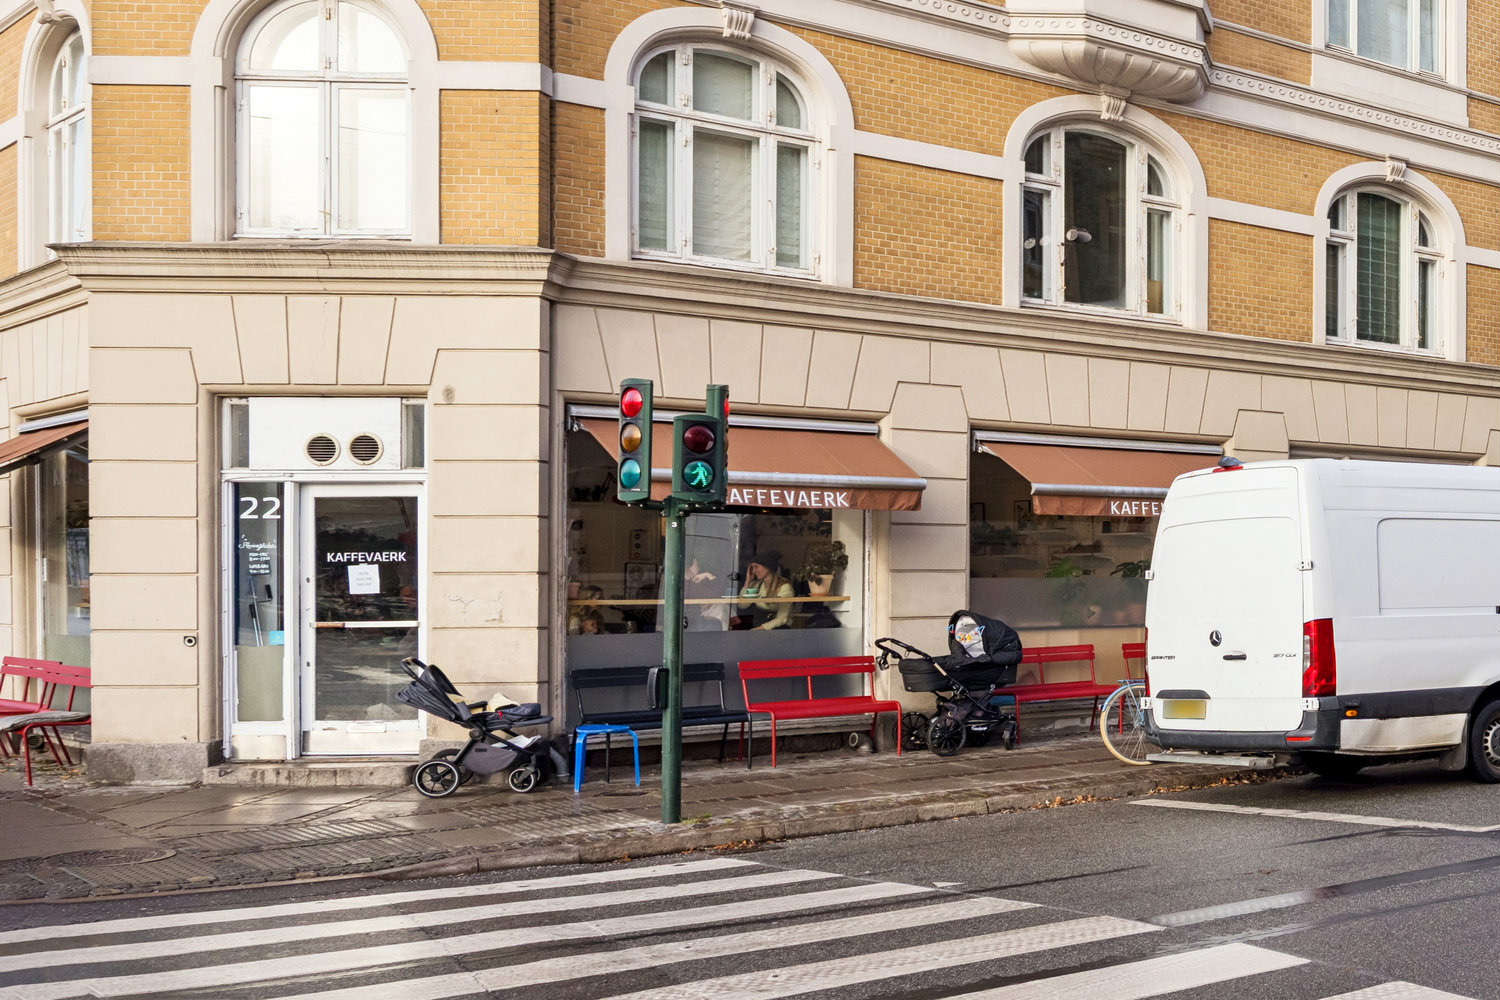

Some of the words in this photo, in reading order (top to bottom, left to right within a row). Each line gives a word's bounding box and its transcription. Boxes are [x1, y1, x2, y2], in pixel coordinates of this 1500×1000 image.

[727, 488, 849, 507] AFFEVAERK
[240, 496, 281, 519] 22
[1110, 501, 1164, 515] KAFFE
[326, 551, 406, 562] KAFFEVAERK
